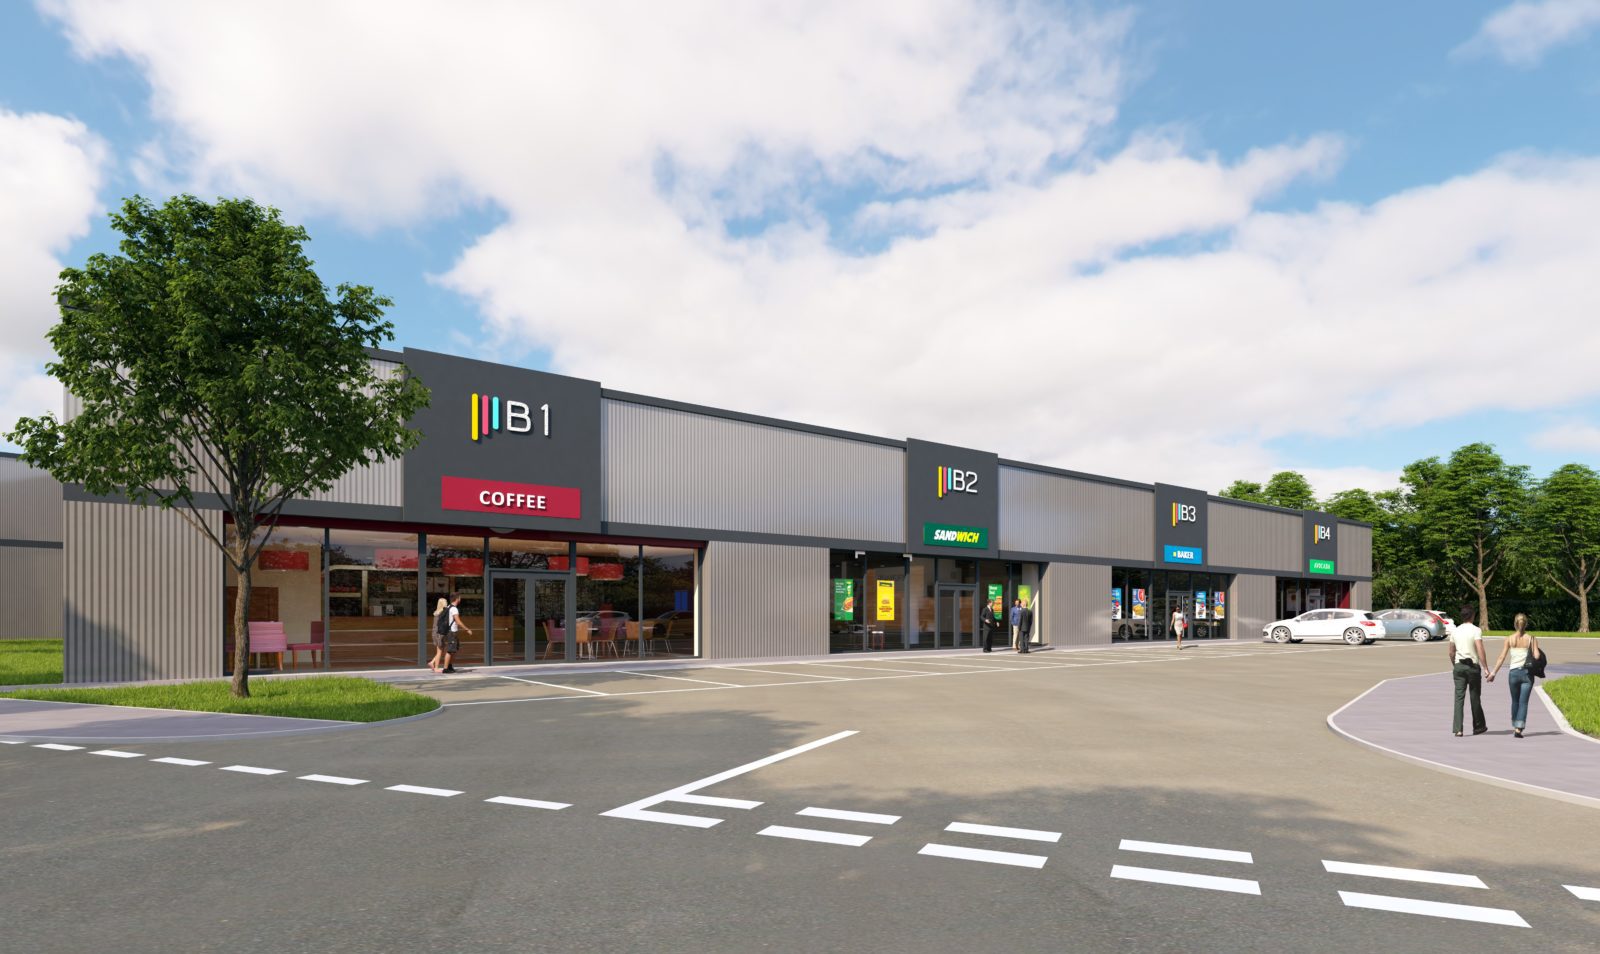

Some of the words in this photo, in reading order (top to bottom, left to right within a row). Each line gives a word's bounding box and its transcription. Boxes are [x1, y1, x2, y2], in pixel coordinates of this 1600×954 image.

[953, 469, 978, 493] B2
[479, 489, 546, 509] COFFEE
[1181, 504, 1196, 522] B3
[933, 529, 980, 544] SANDWICH
[1320, 526, 1330, 540] B4
[1177, 550, 1194, 559] BAKER
